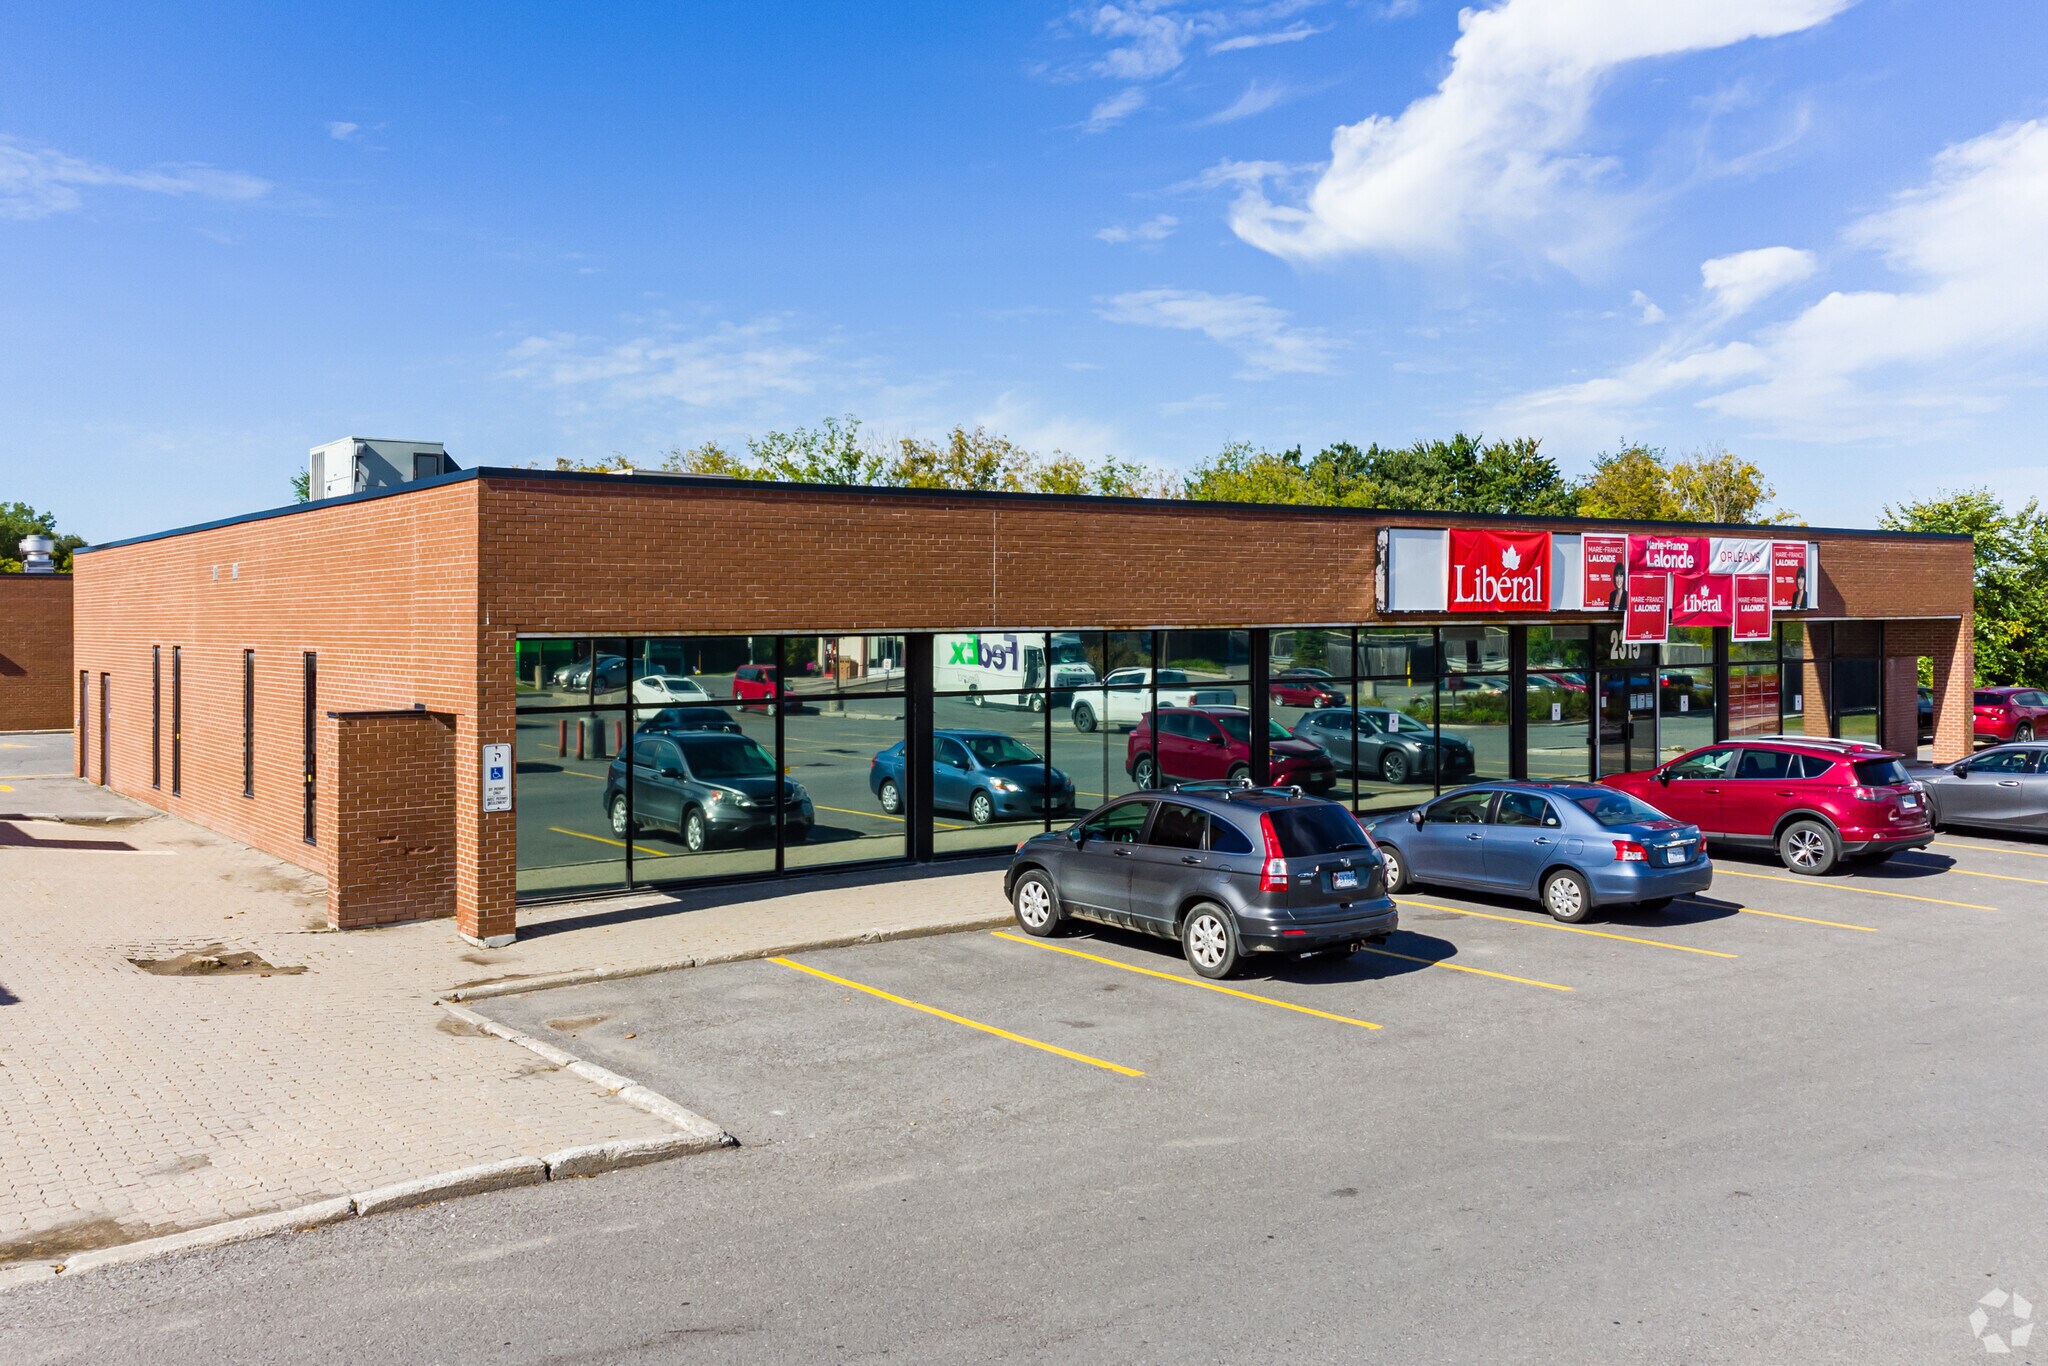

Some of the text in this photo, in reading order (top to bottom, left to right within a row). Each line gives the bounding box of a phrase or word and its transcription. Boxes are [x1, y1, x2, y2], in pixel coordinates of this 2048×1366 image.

[1588, 546, 1623, 554] MARIE-FRANCE
[1646, 540, 1688, 551] Marie-France
[1588, 555, 1616, 563] LALONDE
[1646, 550, 1694, 569] Lalonde
[1775, 559, 1799, 567] LALONDE
[1453, 564, 1543, 603] Libéral
[1683, 594, 1722, 613] Libéral
[1741, 604, 1765, 612] LALONDE
[1634, 604, 1661, 613] LALONDE
